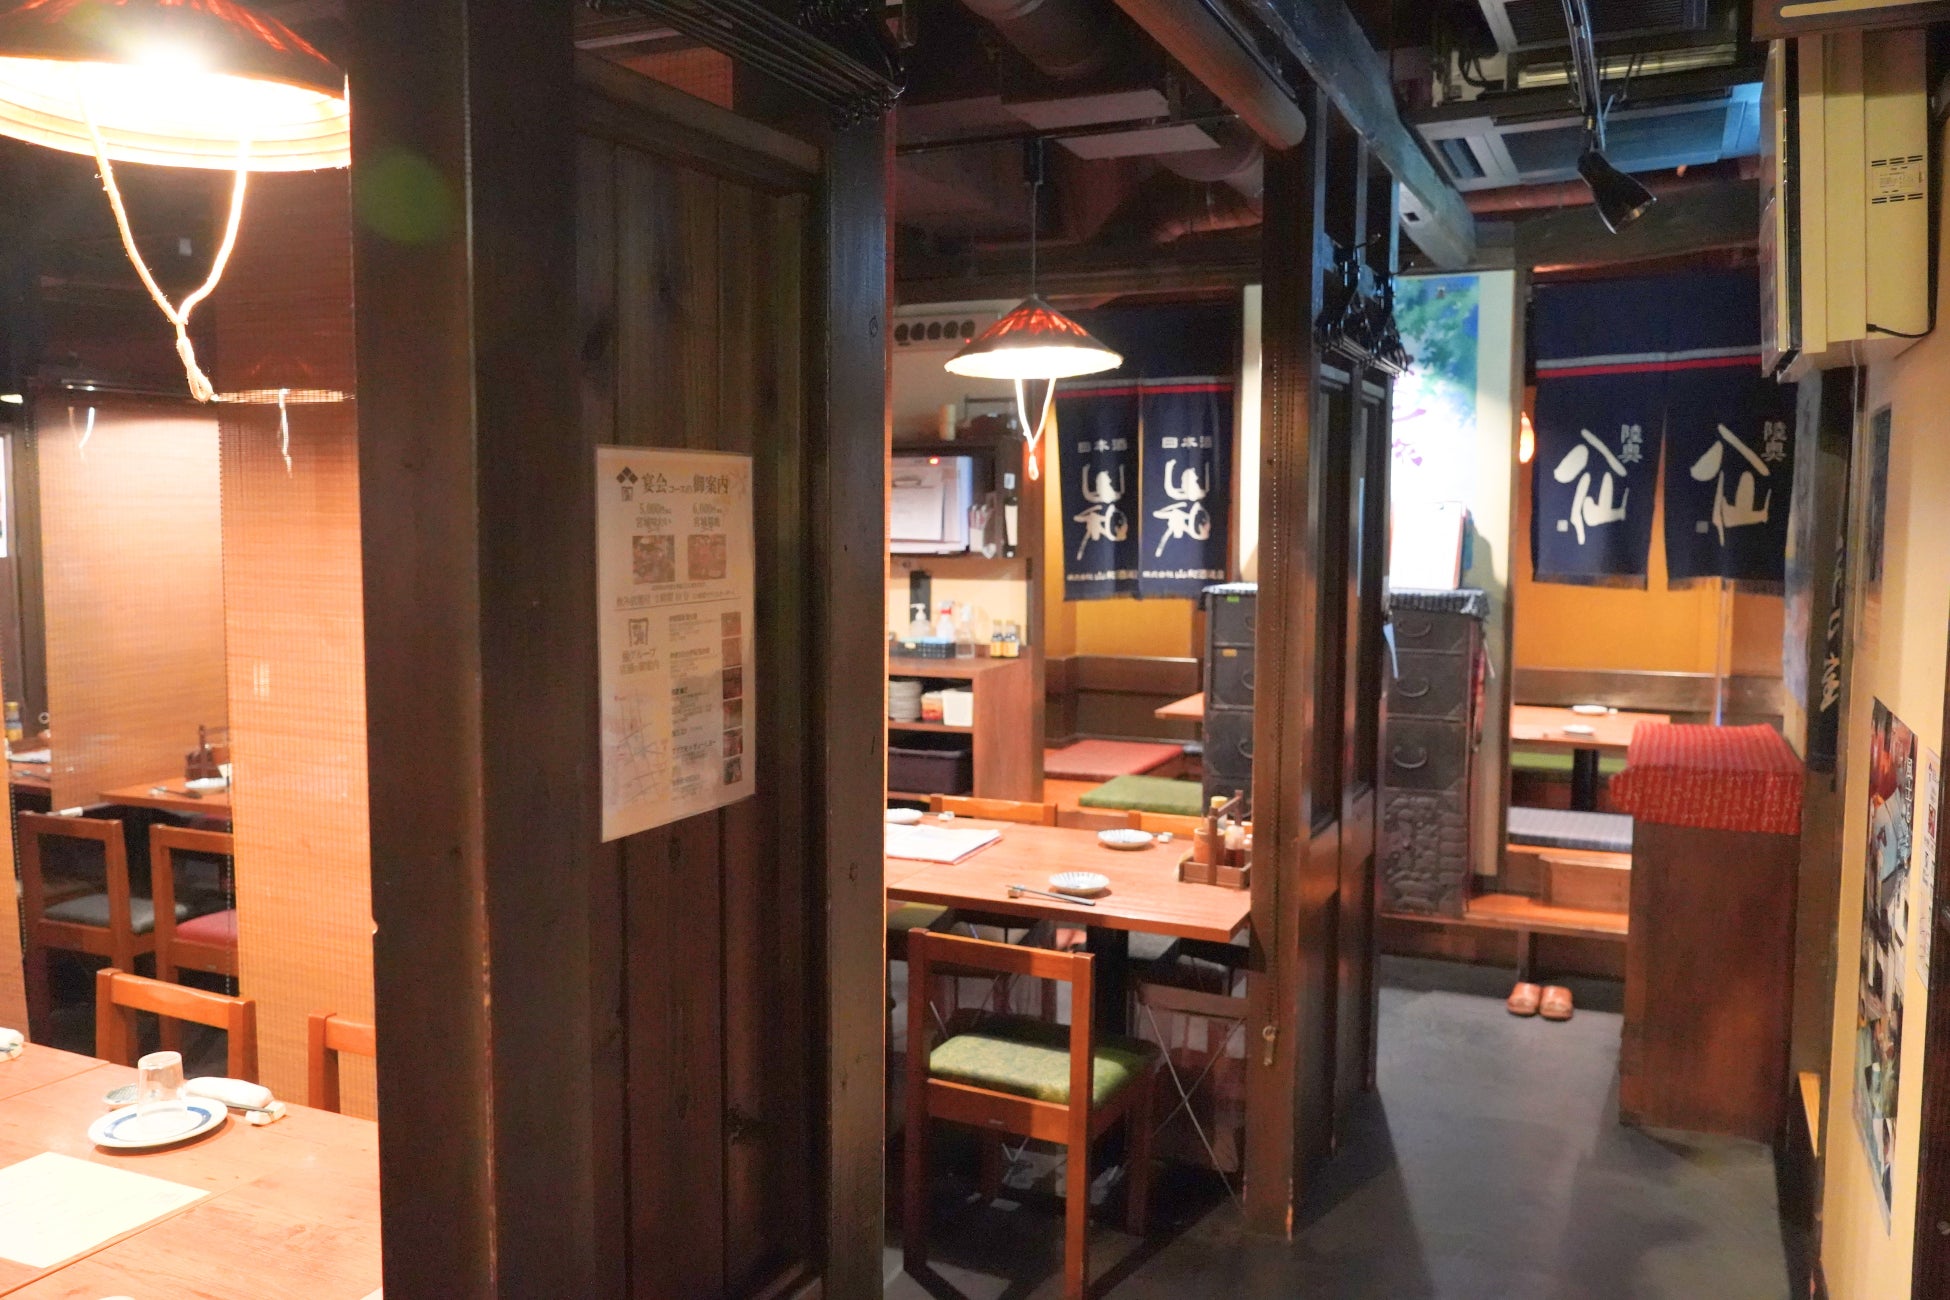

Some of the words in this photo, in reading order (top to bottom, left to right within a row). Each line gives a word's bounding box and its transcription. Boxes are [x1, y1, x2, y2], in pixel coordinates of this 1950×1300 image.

[1078, 438, 1128, 453] 日本酒
[1161, 436, 1213, 449] 日本酒
